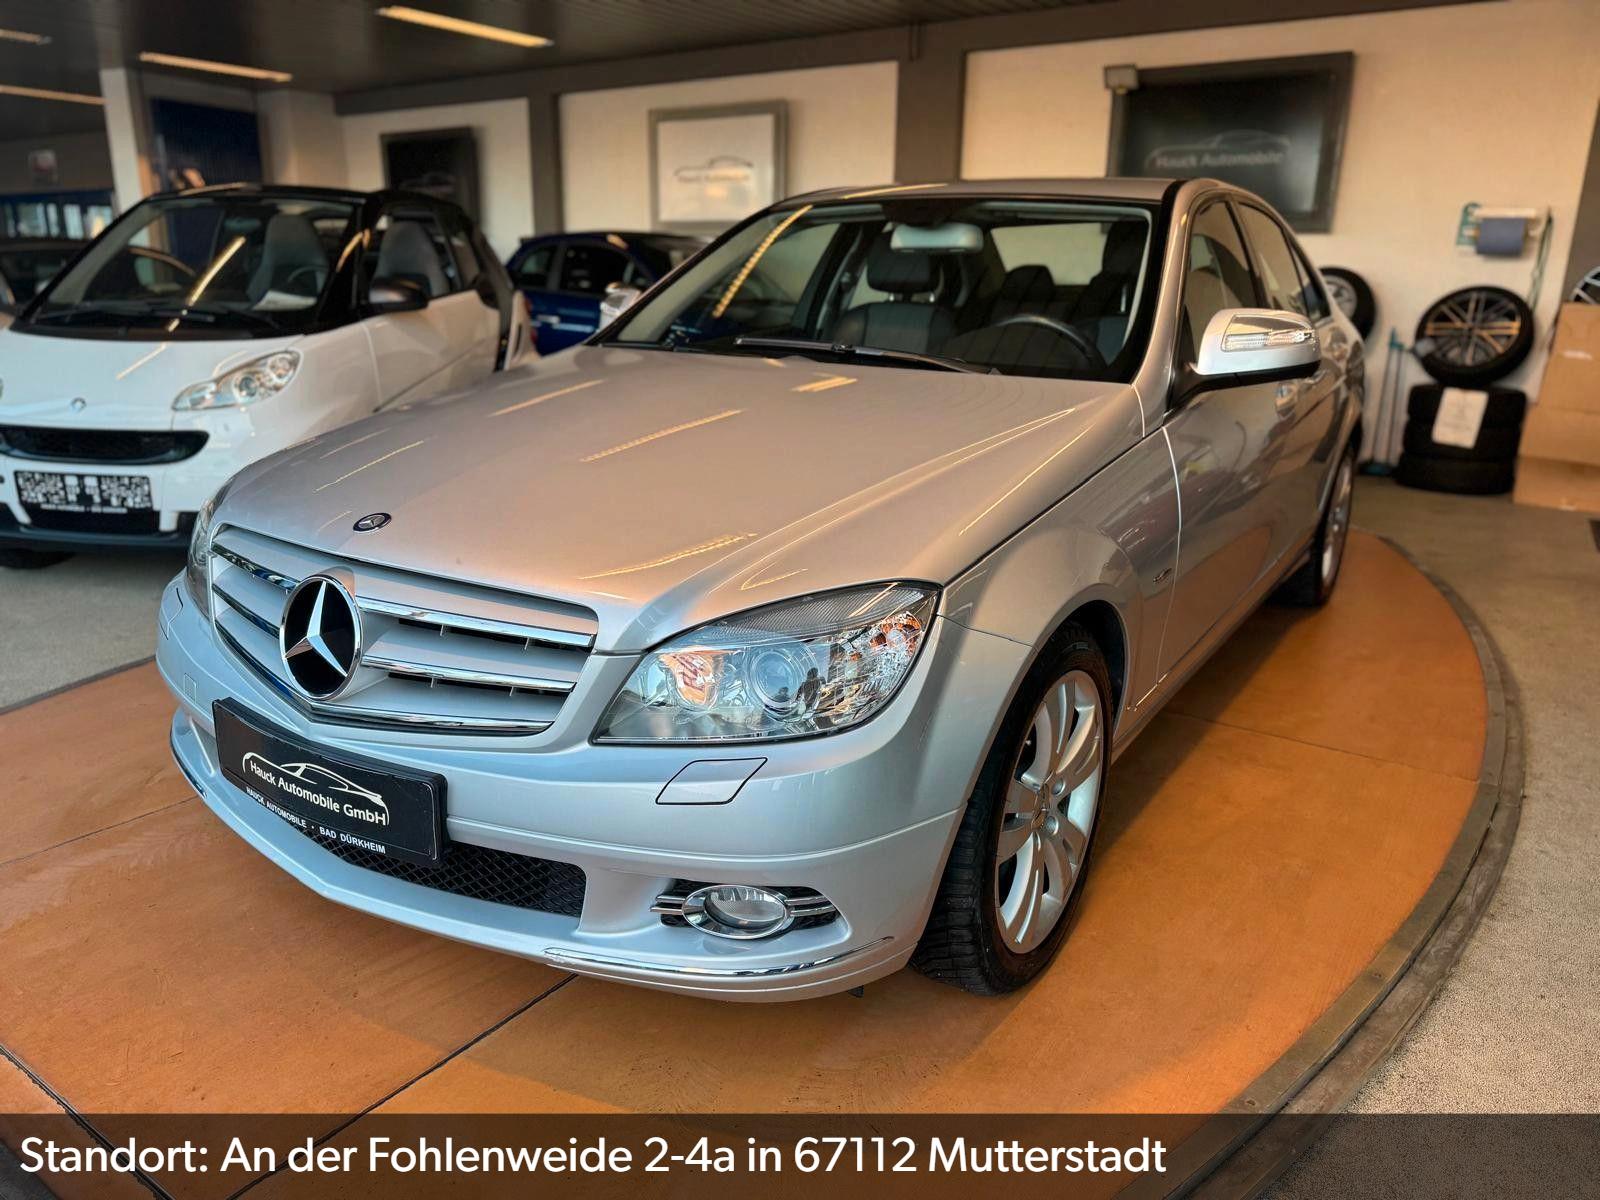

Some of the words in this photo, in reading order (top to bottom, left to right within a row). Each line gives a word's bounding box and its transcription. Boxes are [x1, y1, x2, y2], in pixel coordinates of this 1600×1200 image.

[246, 787, 265, 805] HAUCK
[266, 802, 307, 828] AUTOMOBILE
[319, 826, 338, 839] BAD
[340, 833, 386, 854] DÜRKHEIM
[249, 760, 276, 786] Hauck
[278, 777, 340, 813] Automobile
[343, 803, 387, 826] GmbH
